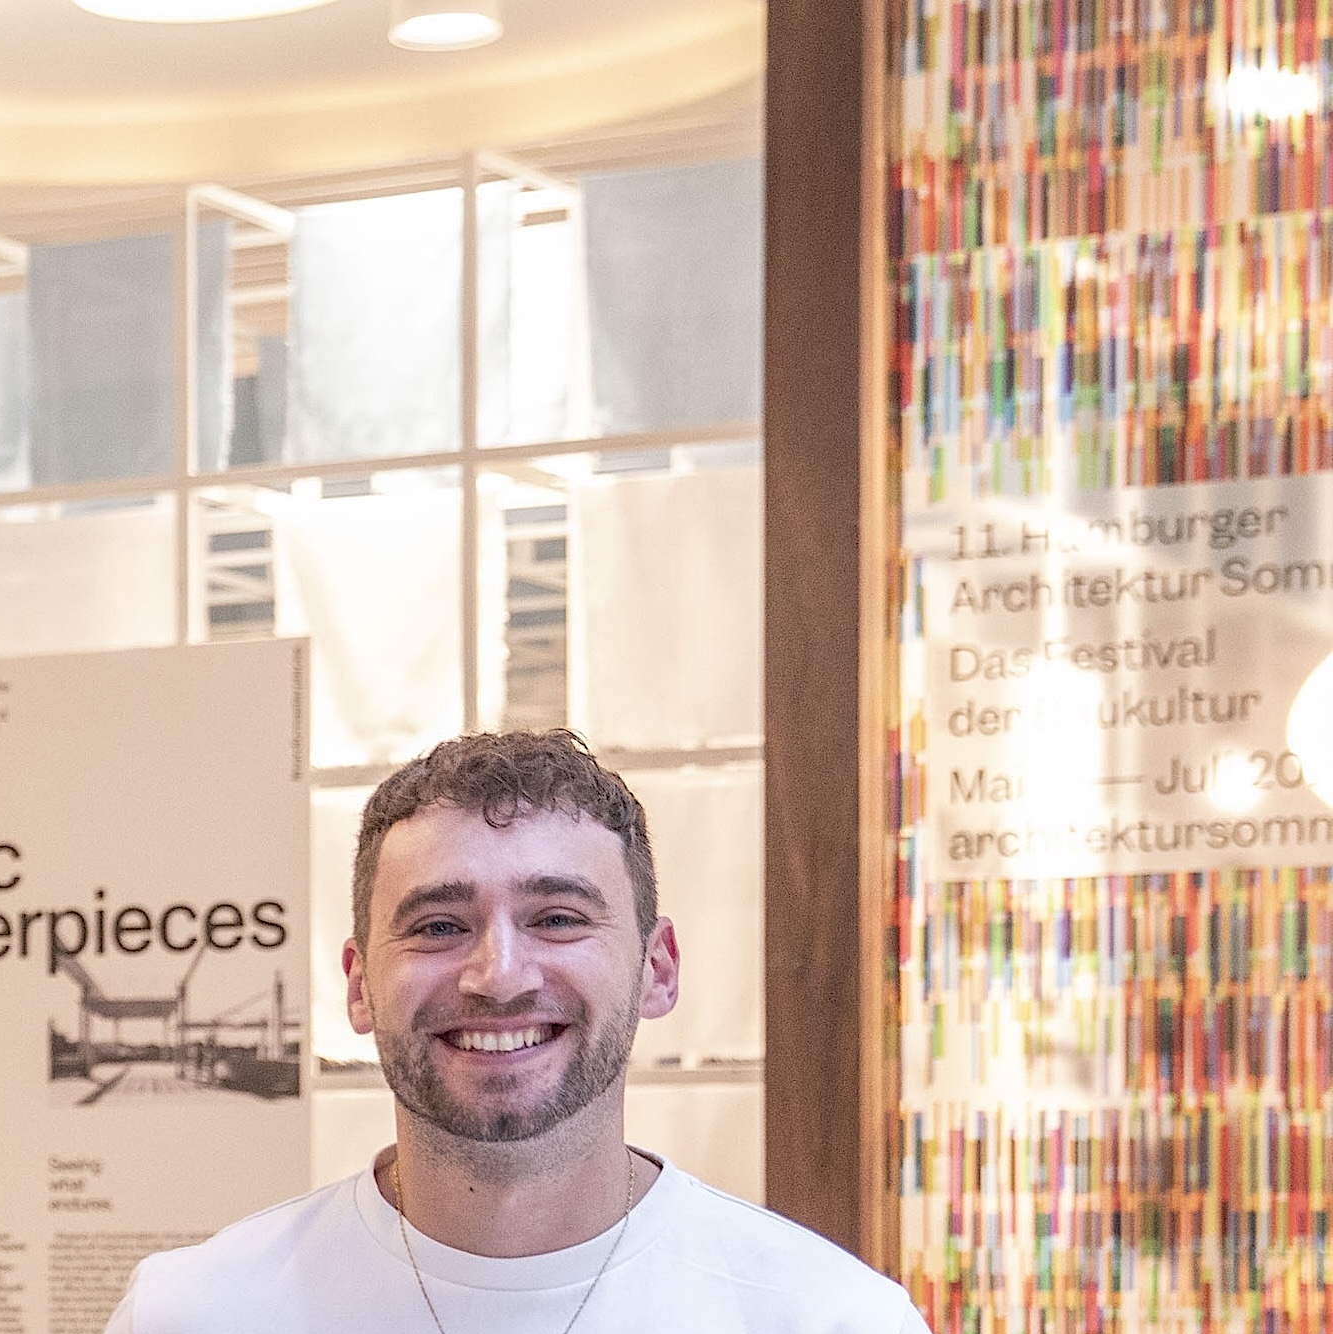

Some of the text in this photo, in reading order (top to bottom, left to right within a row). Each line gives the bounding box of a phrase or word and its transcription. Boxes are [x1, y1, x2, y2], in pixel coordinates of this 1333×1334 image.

[1021, 505, 1289, 550] Hmburger
[950, 556, 1333, 613] Architektur Som
[949, 643, 1034, 682] Das
[947, 687, 1263, 738] der ukultur
[1155, 751, 1223, 796] Jul
